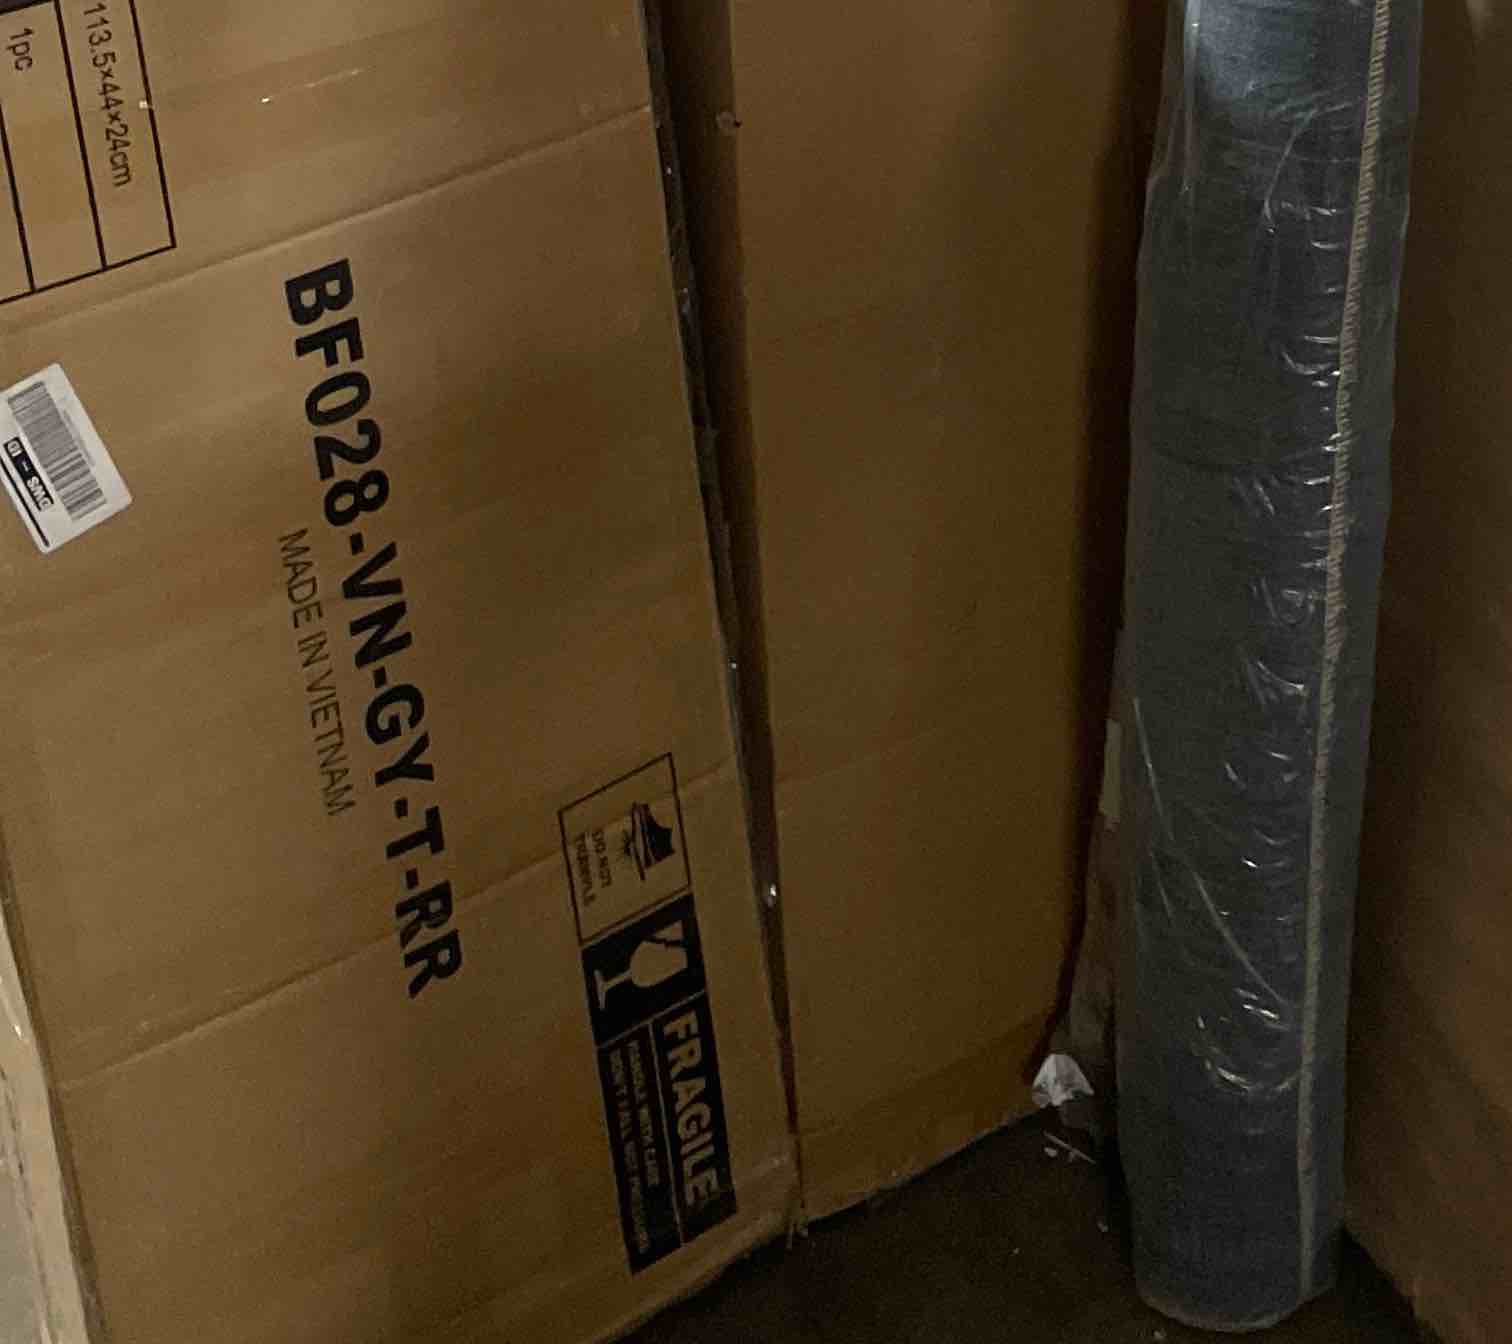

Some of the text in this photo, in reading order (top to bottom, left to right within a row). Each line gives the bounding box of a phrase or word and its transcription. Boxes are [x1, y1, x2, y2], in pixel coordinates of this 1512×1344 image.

[9, 28, 33, 72] 1pc
[7, 440, 24, 459] ID
[278, 529, 357, 817] MADE IN VIETNAM
[284, 257, 464, 998] BF028-VN-GY-T-RR
[663, 1010, 719, 1209] FRAGILE
